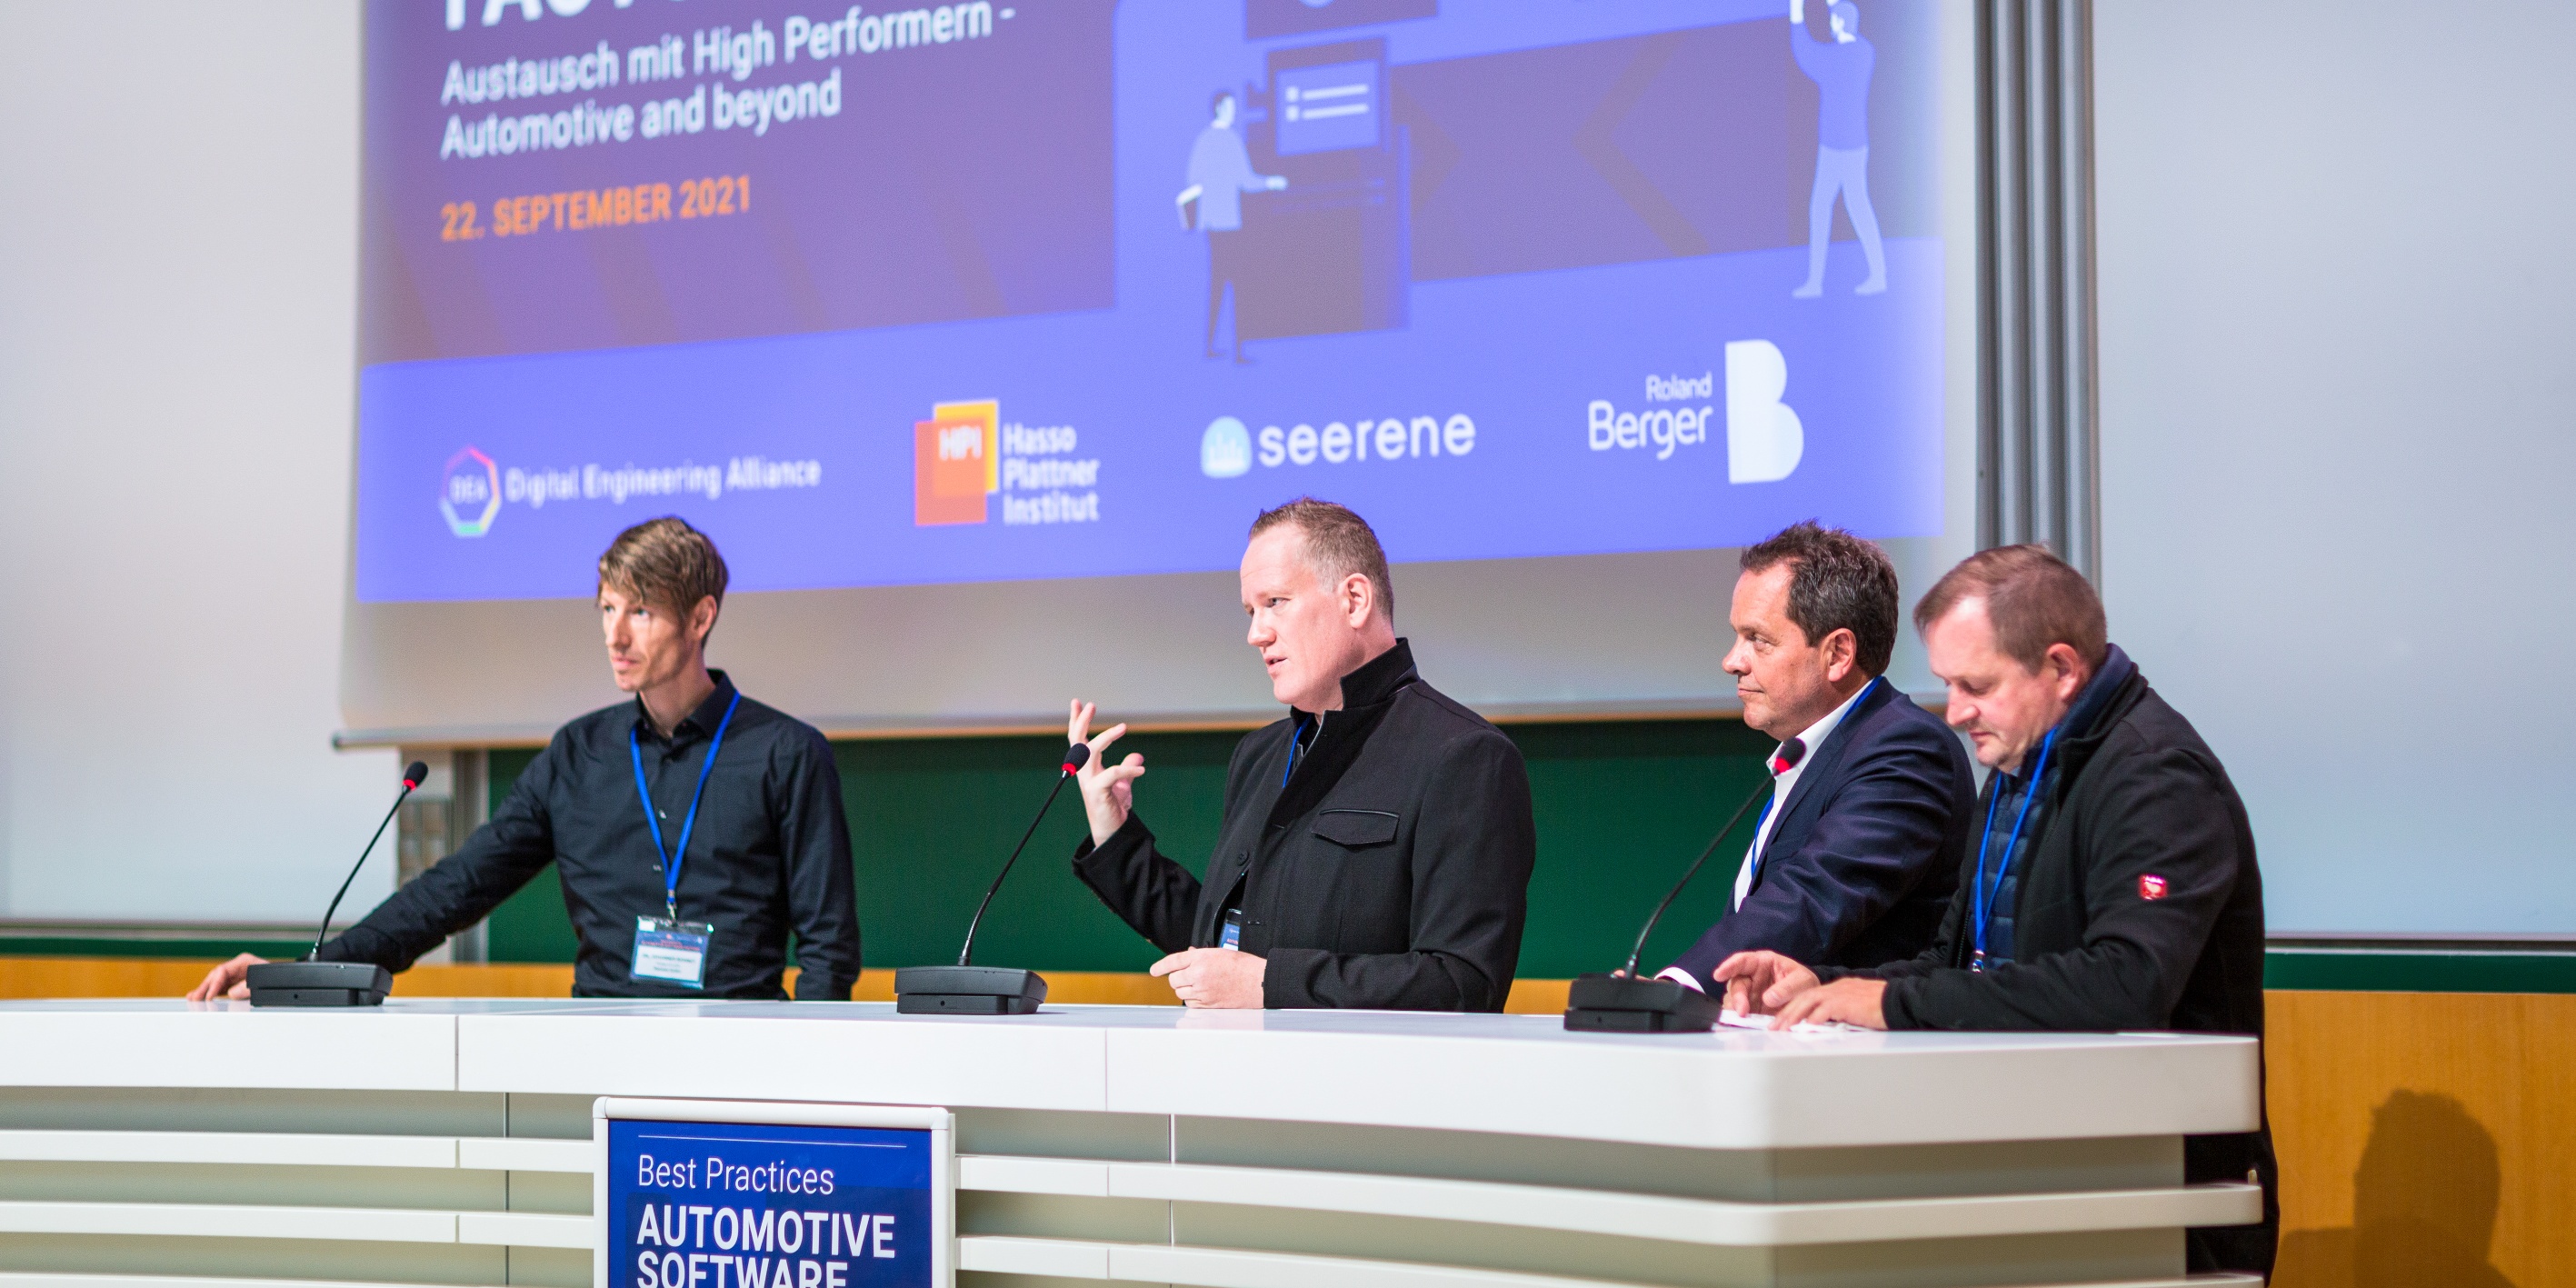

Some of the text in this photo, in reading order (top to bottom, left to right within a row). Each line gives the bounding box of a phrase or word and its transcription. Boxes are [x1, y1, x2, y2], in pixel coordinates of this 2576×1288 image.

[440, 39, 620, 106] Austausch
[627, 33, 685, 84] mit
[694, 19, 775, 81] High
[784, 1, 993, 63] Performern
[440, 66, 842, 160] Automotive and beyond
[441, 175, 750, 242] 22. SEPTEMBER 2021
[1645, 371, 1712, 402] Roland
[938, 425, 983, 461] HPI
[1003, 423, 1077, 454] Hasso
[1259, 414, 1476, 467] seerene
[1588, 400, 1712, 461] Berger
[504, 455, 821, 509] Digital Engineering Alliance
[1003, 457, 1099, 490] Plattner
[1003, 490, 1100, 524] Institut
[638, 1154, 834, 1196] Best Practices
[636, 1203, 896, 1260] AUTOMOTIVE
[636, 1250, 849, 1288] SOFTWARE
